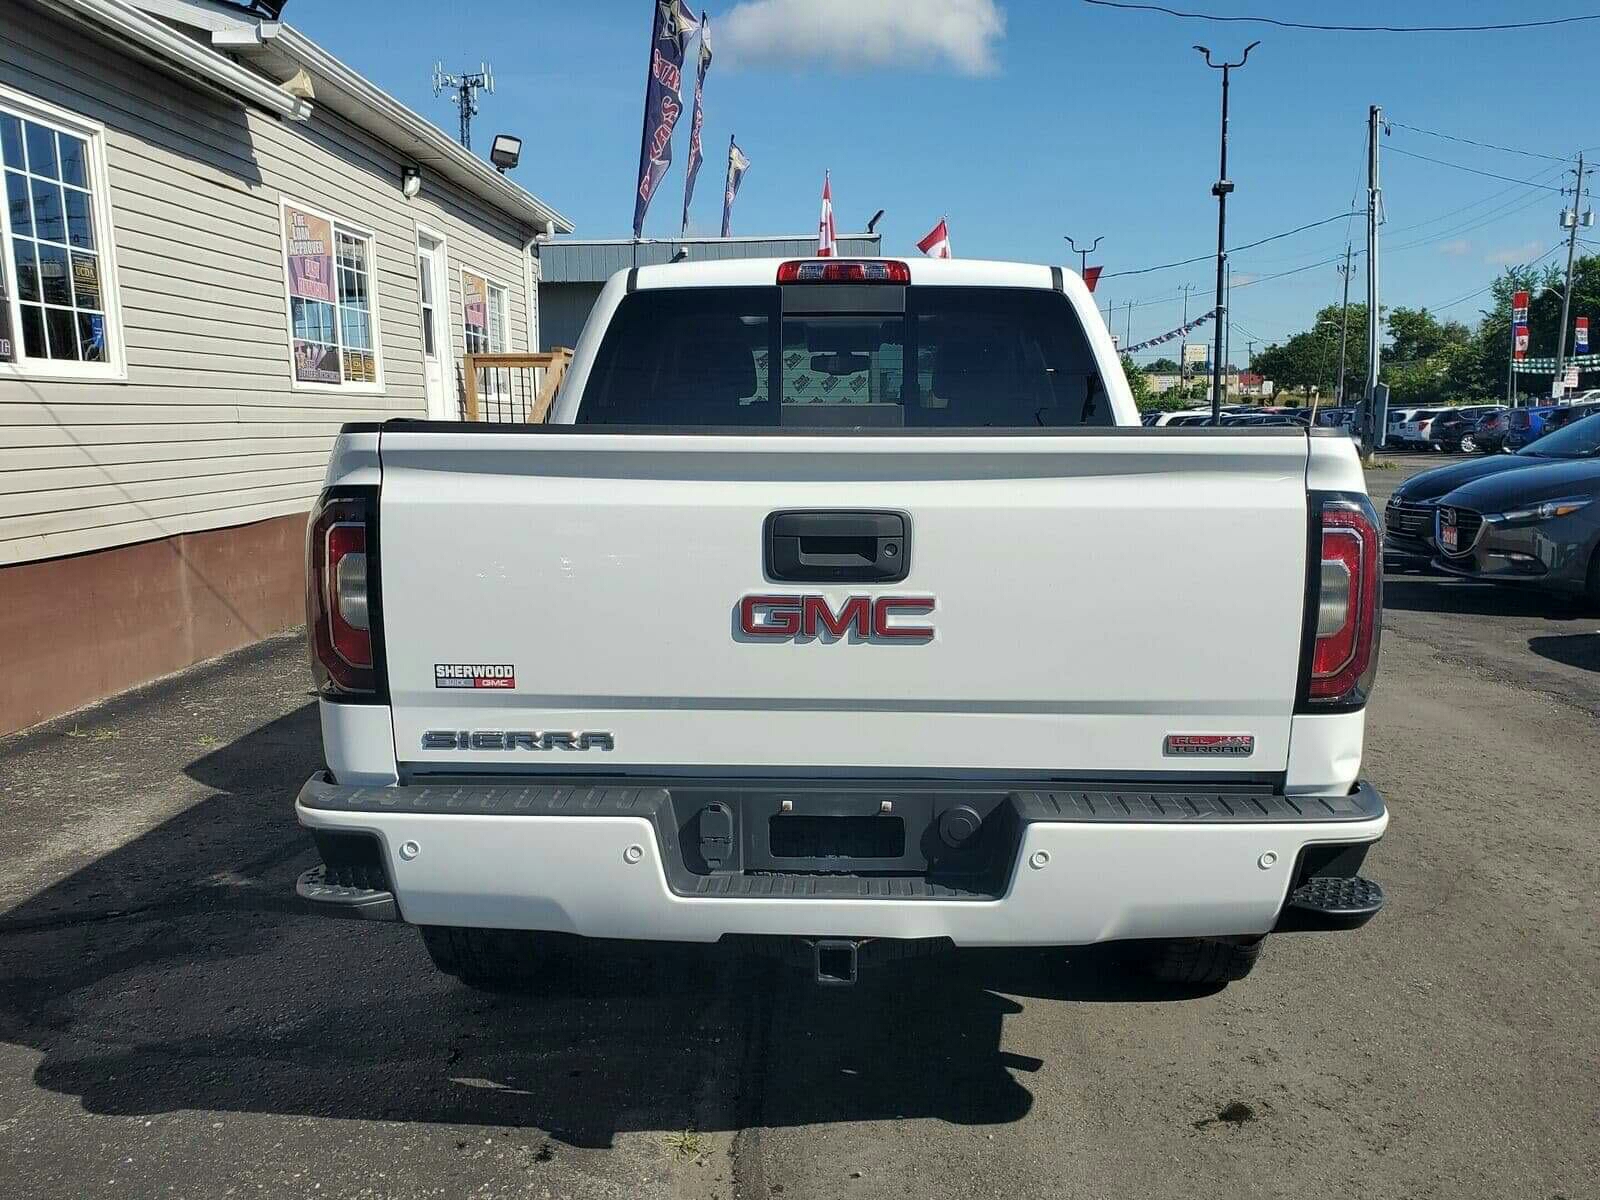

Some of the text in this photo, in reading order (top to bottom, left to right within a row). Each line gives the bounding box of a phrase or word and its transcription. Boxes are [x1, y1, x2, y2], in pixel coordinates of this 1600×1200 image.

[289, 239, 324, 255] APPROVER
[75, 266, 95, 278] UCDA
[739, 594, 936, 641] GMC
[436, 665, 514, 678] SHERWOOD
[482, 679, 509, 687] GMC
[422, 730, 615, 752] SIERRA
[1173, 745, 1251, 753] TERRAIN
